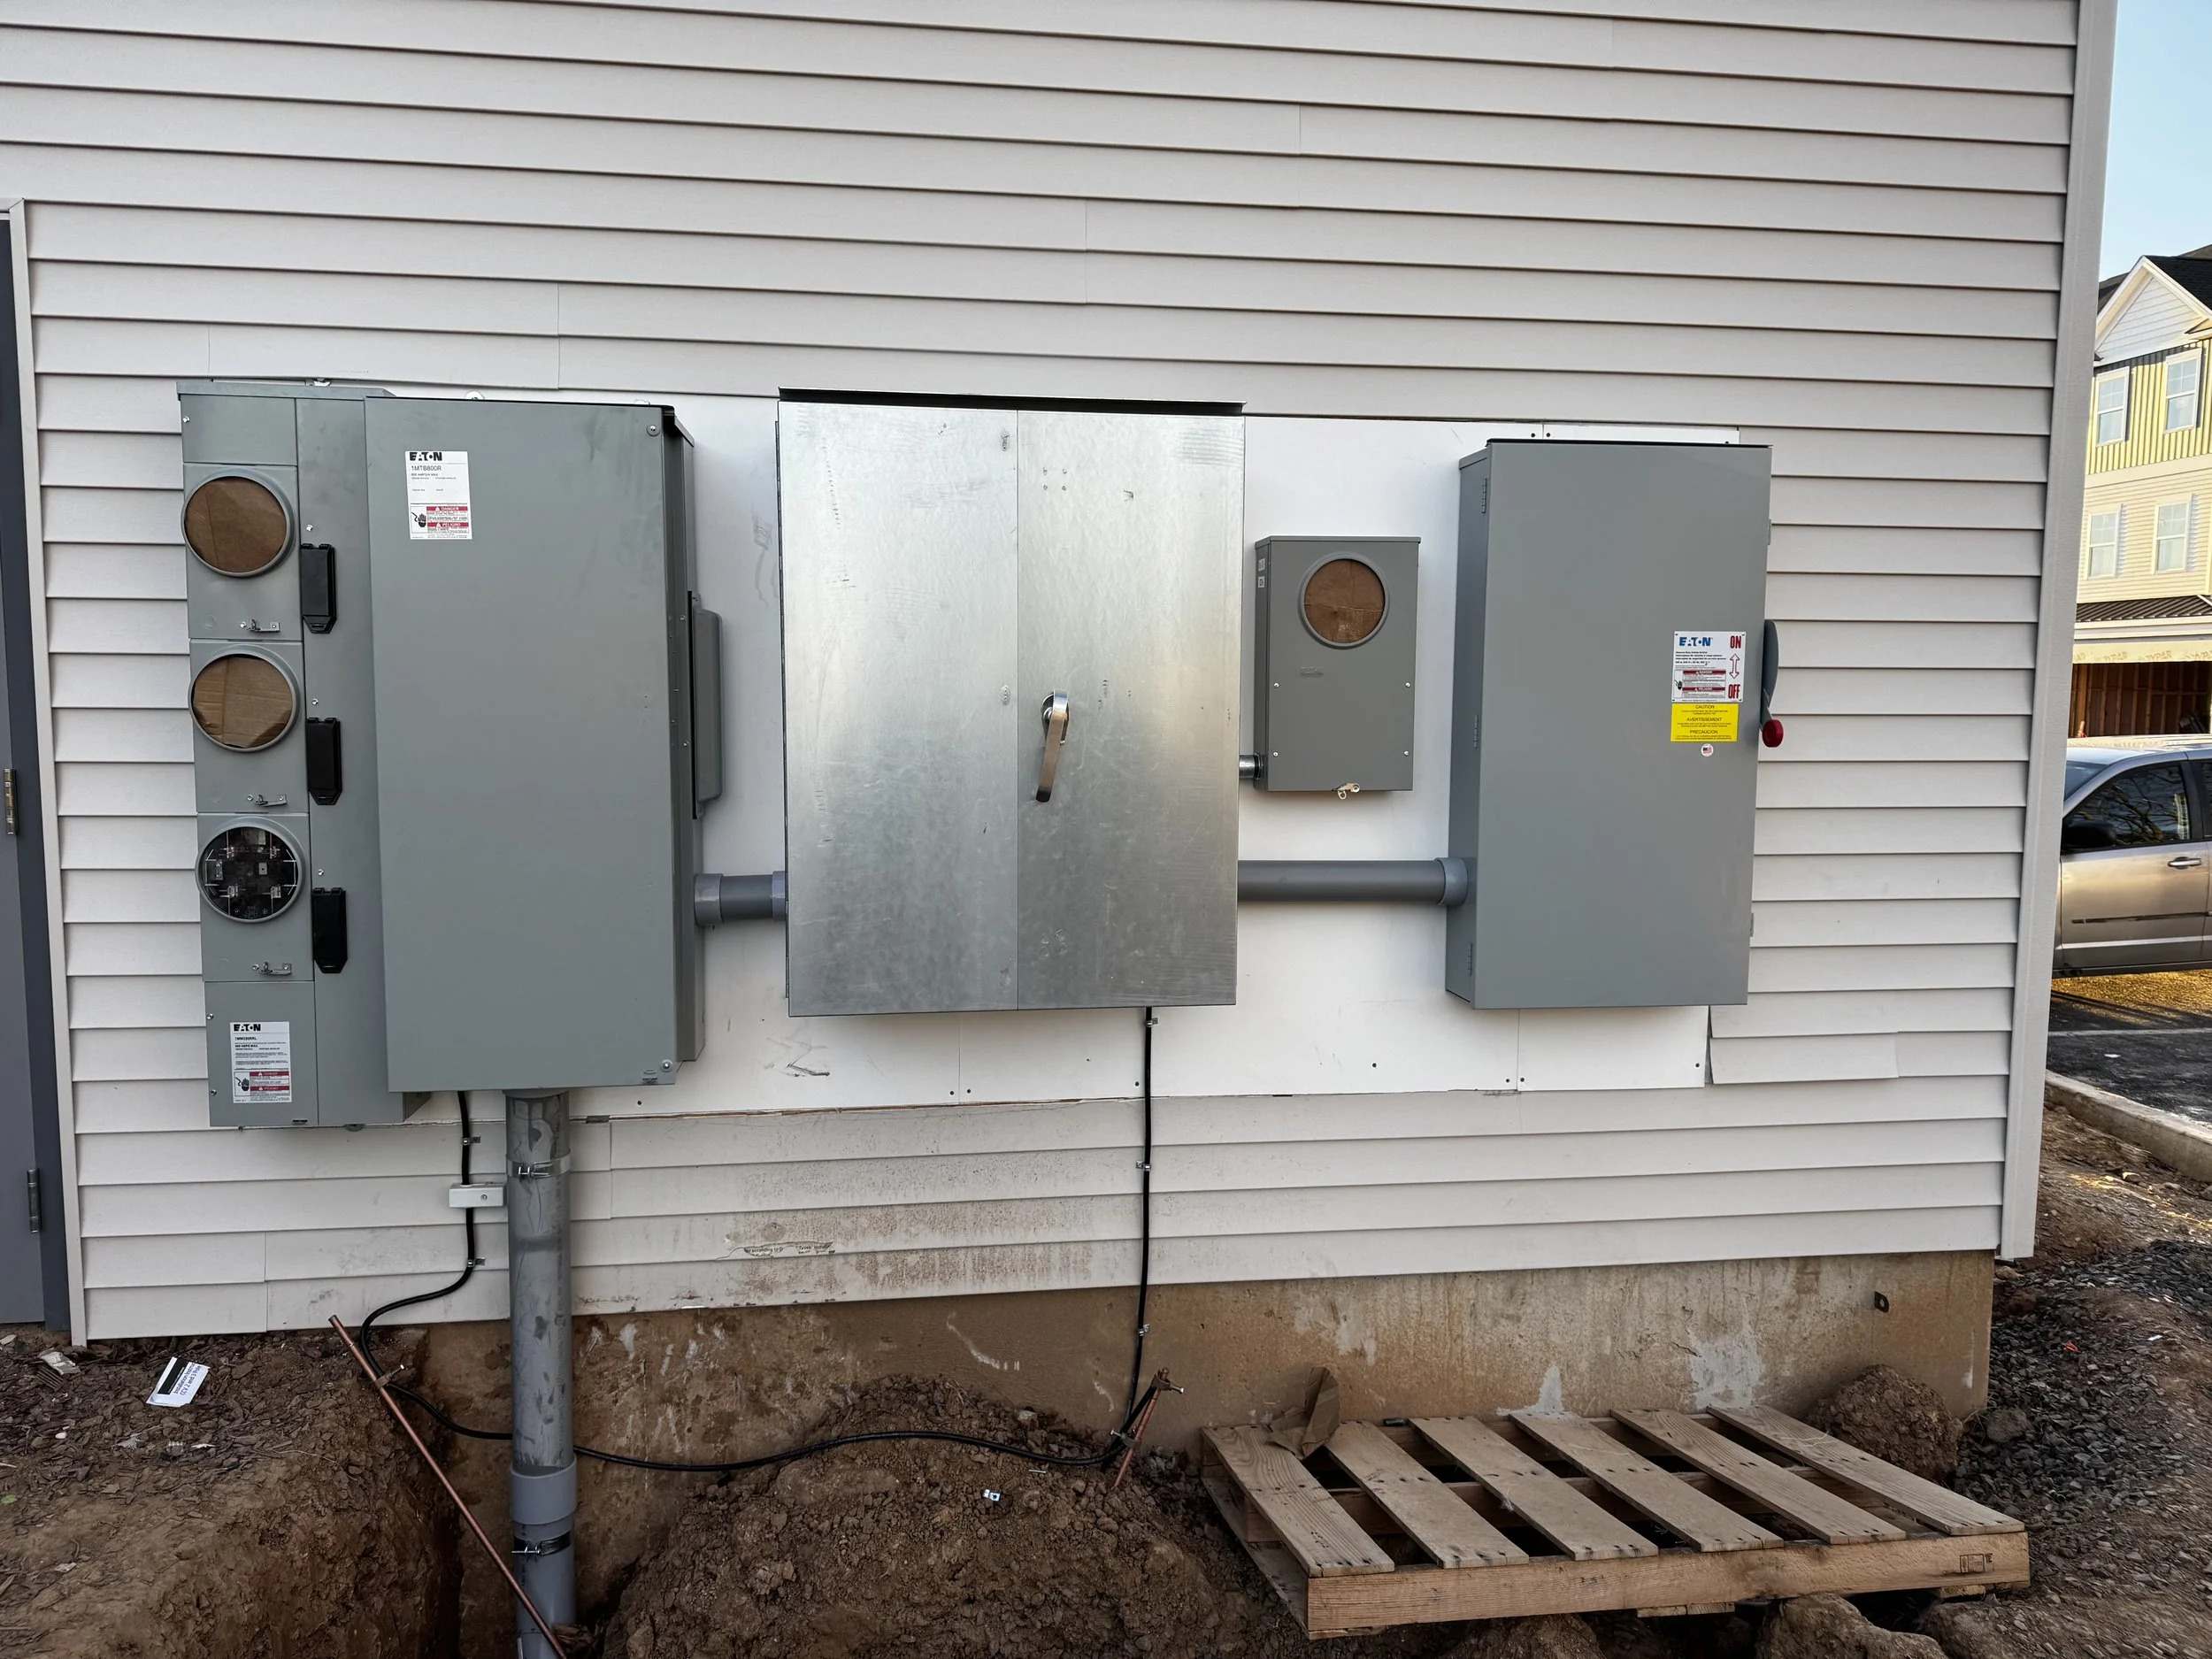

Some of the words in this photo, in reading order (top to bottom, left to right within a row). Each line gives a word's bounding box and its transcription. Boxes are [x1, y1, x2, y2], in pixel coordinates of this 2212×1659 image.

[410, 452, 442, 461] EATON
[1679, 637, 1711, 646] EATON
[1730, 635, 1742, 649] ON
[2146, 650, 2172, 660] TYPAR
[1728, 684, 1741, 699] OFF
